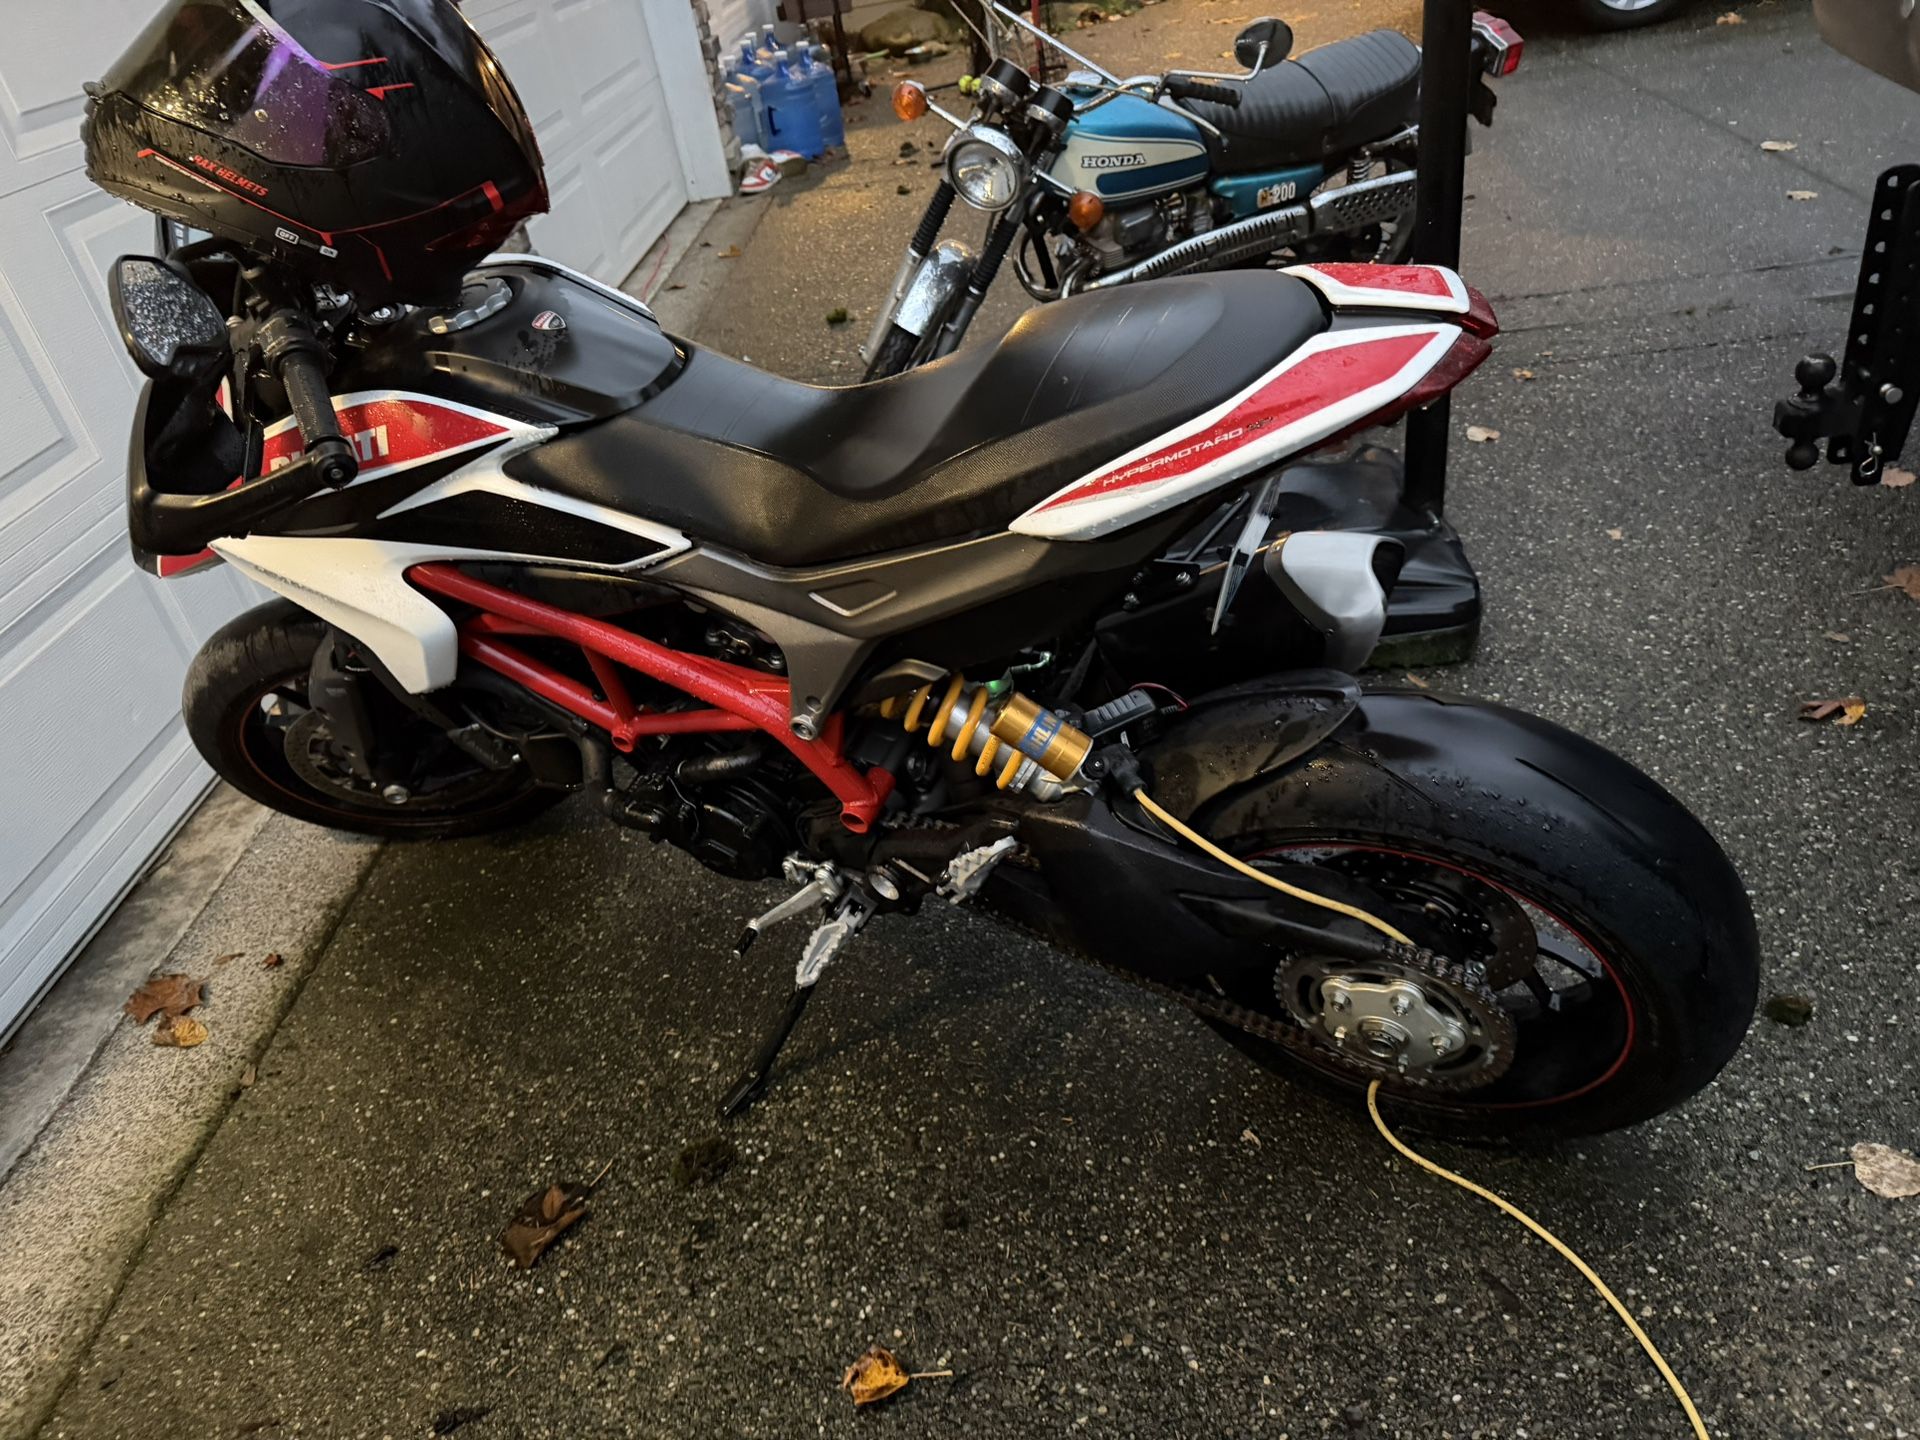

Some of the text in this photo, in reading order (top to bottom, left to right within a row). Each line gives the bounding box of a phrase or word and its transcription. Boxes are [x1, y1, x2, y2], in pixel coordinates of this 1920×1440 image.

[1081, 153, 1146, 168] HONDA
[215, 166, 269, 197] HELMETS
[269, 424, 389, 473] DTI
[1103, 427, 1244, 487] HYPERMOTARD
